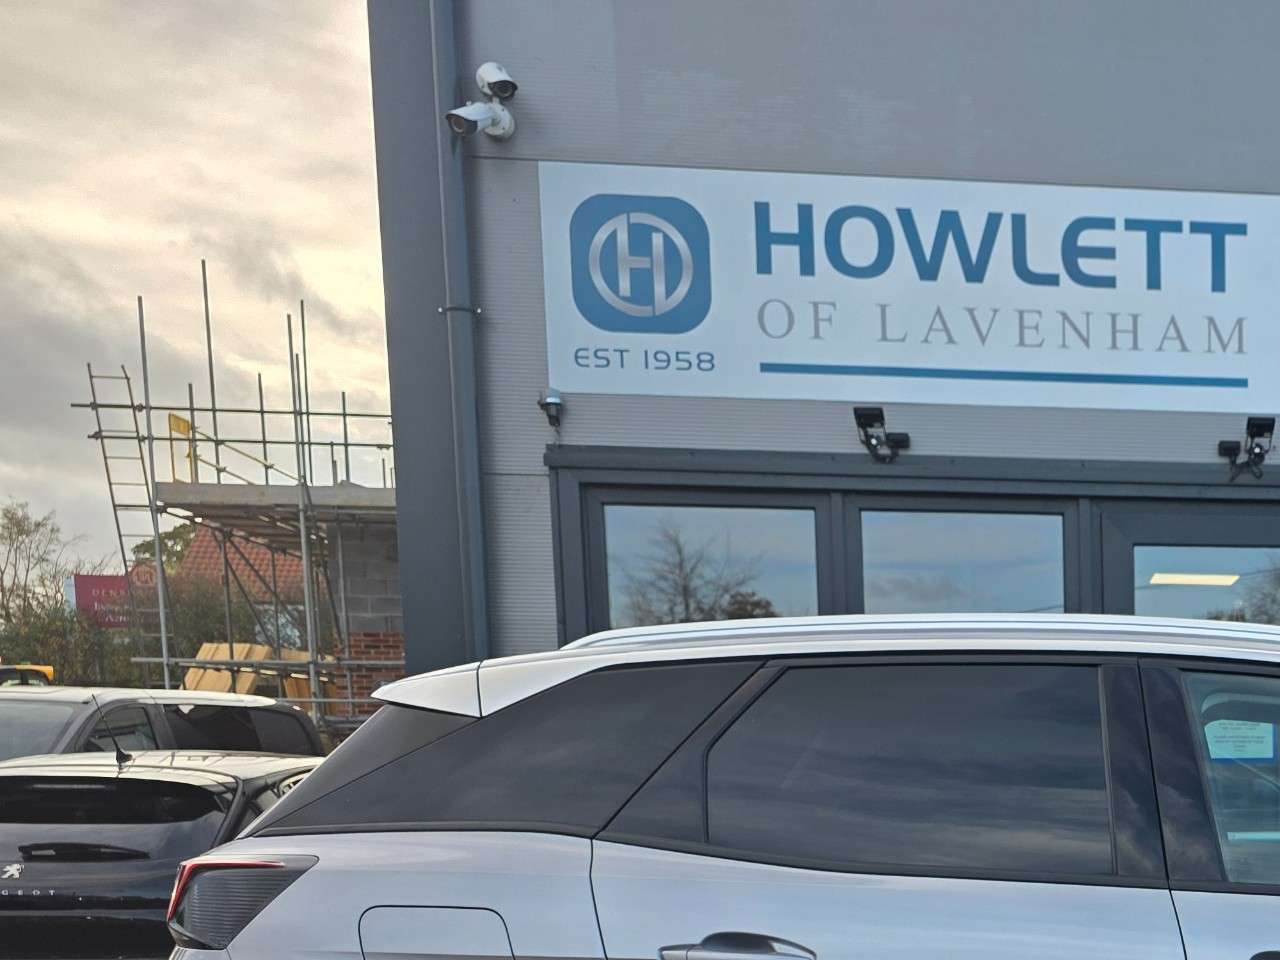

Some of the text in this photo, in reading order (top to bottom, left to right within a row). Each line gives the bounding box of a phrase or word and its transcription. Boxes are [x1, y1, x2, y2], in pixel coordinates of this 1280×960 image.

[754, 201, 1247, 293] HOWLETT
[757, 299, 1248, 354] OF LAVENHAM
[574, 347, 716, 372] EST 1958
